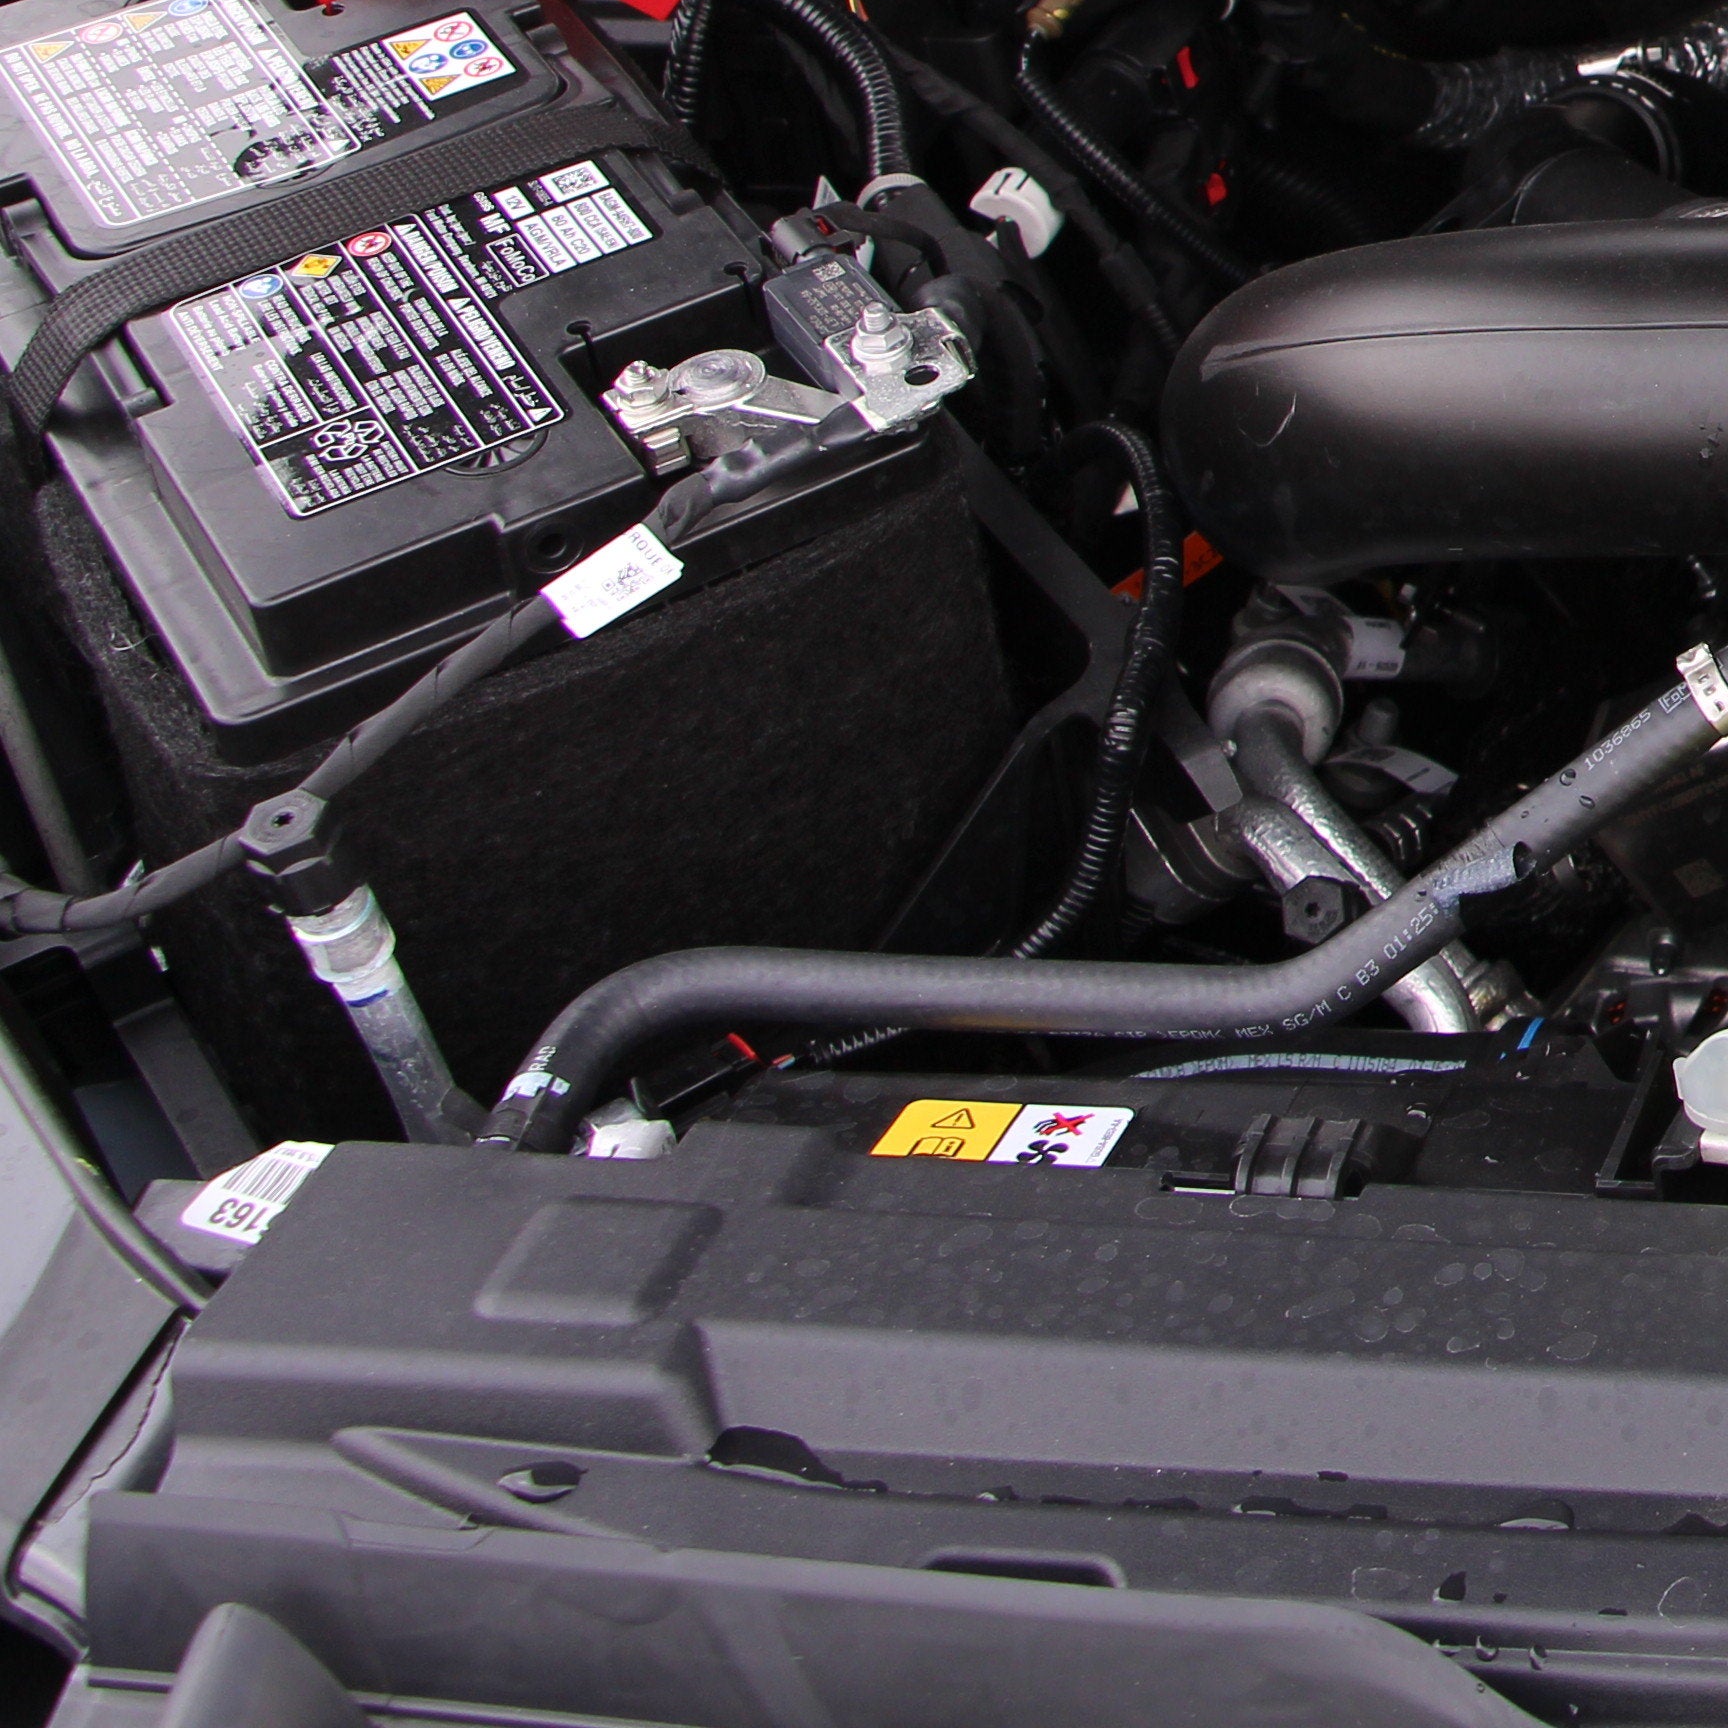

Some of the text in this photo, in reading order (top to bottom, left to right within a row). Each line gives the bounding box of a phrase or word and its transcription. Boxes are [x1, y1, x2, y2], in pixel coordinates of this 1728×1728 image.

[502, 193, 526, 211] 12V
[476, 211, 512, 236] MF
[559, 226, 578, 239] Ah
[582, 213, 604, 229] CCA
[522, 221, 568, 267] AGM/VRLA
[568, 237, 591, 255] C20
[491, 237, 541, 283] FoMoCo
[1583, 708, 1652, 771] 1036865
[1234, 1024, 1275, 1039] MEX
[1281, 998, 1333, 1031] SG/M
[1336, 985, 1352, 1001] C
[1355, 958, 1380, 987] B3
